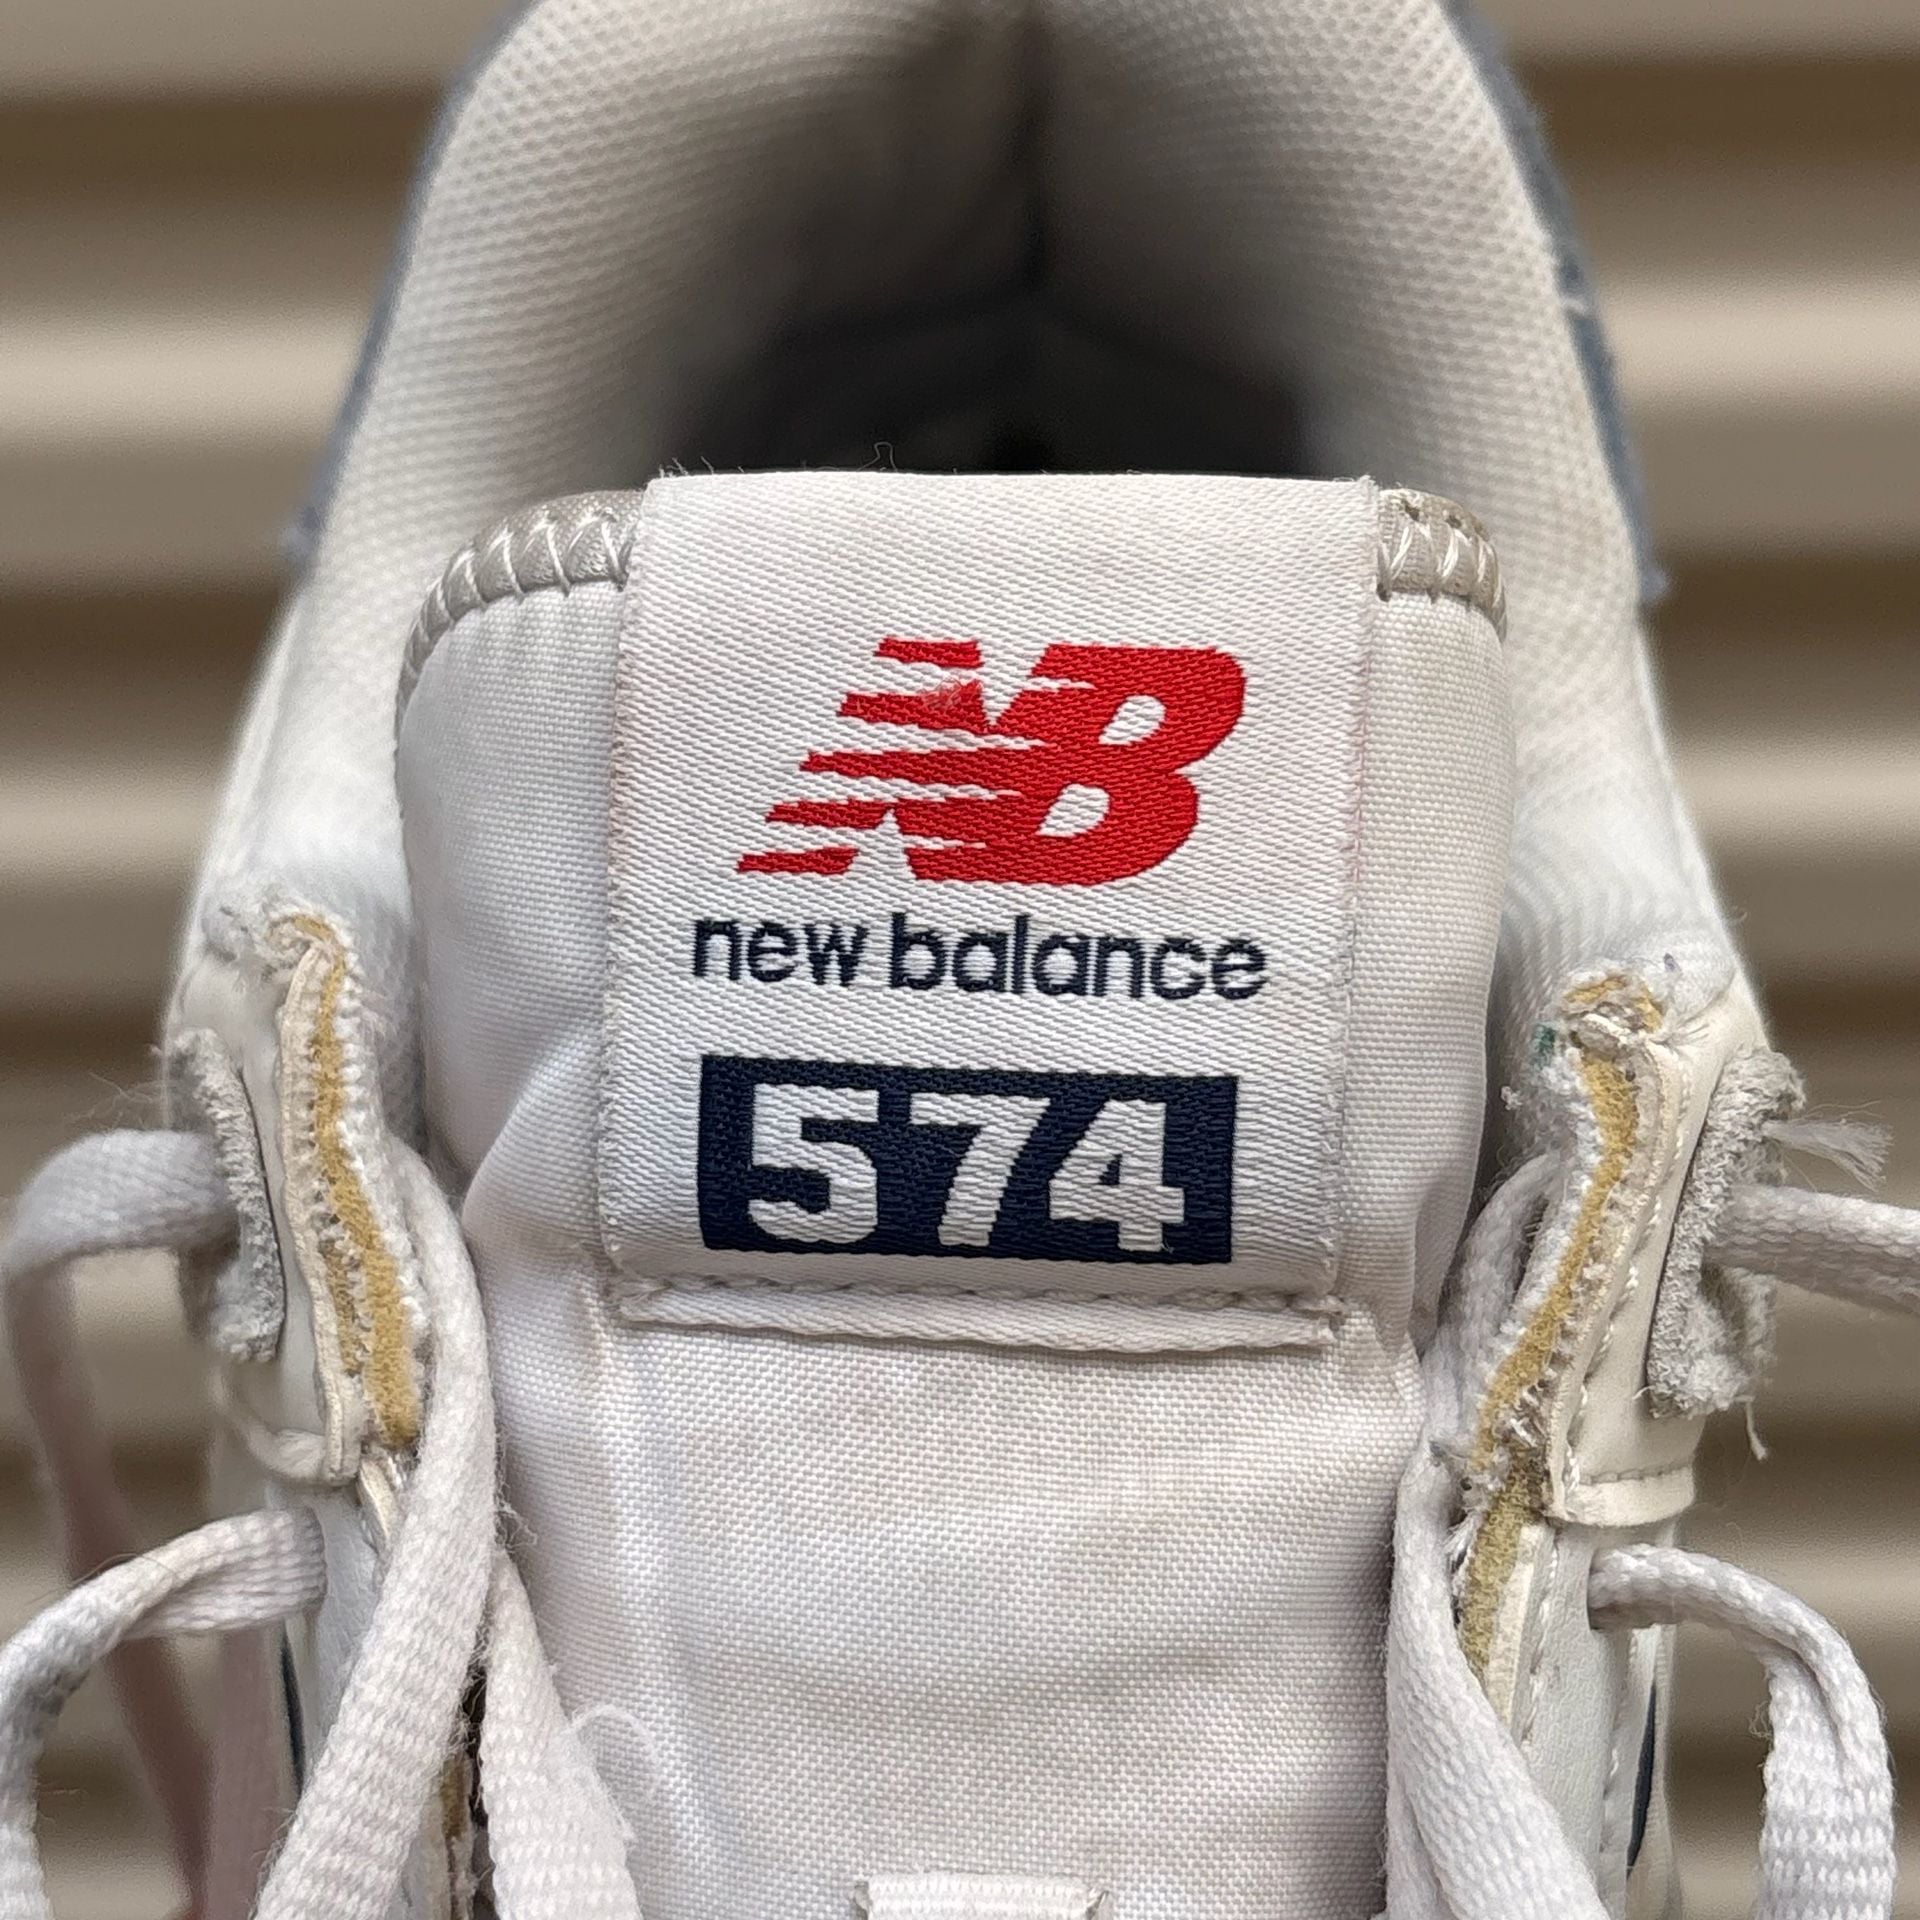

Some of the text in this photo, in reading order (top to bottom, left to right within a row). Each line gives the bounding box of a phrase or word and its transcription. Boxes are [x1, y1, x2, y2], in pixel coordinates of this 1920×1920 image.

[737, 636, 1247, 885] NB
[692, 911, 1269, 1001] new balance
[747, 1083, 1185, 1254] 574
